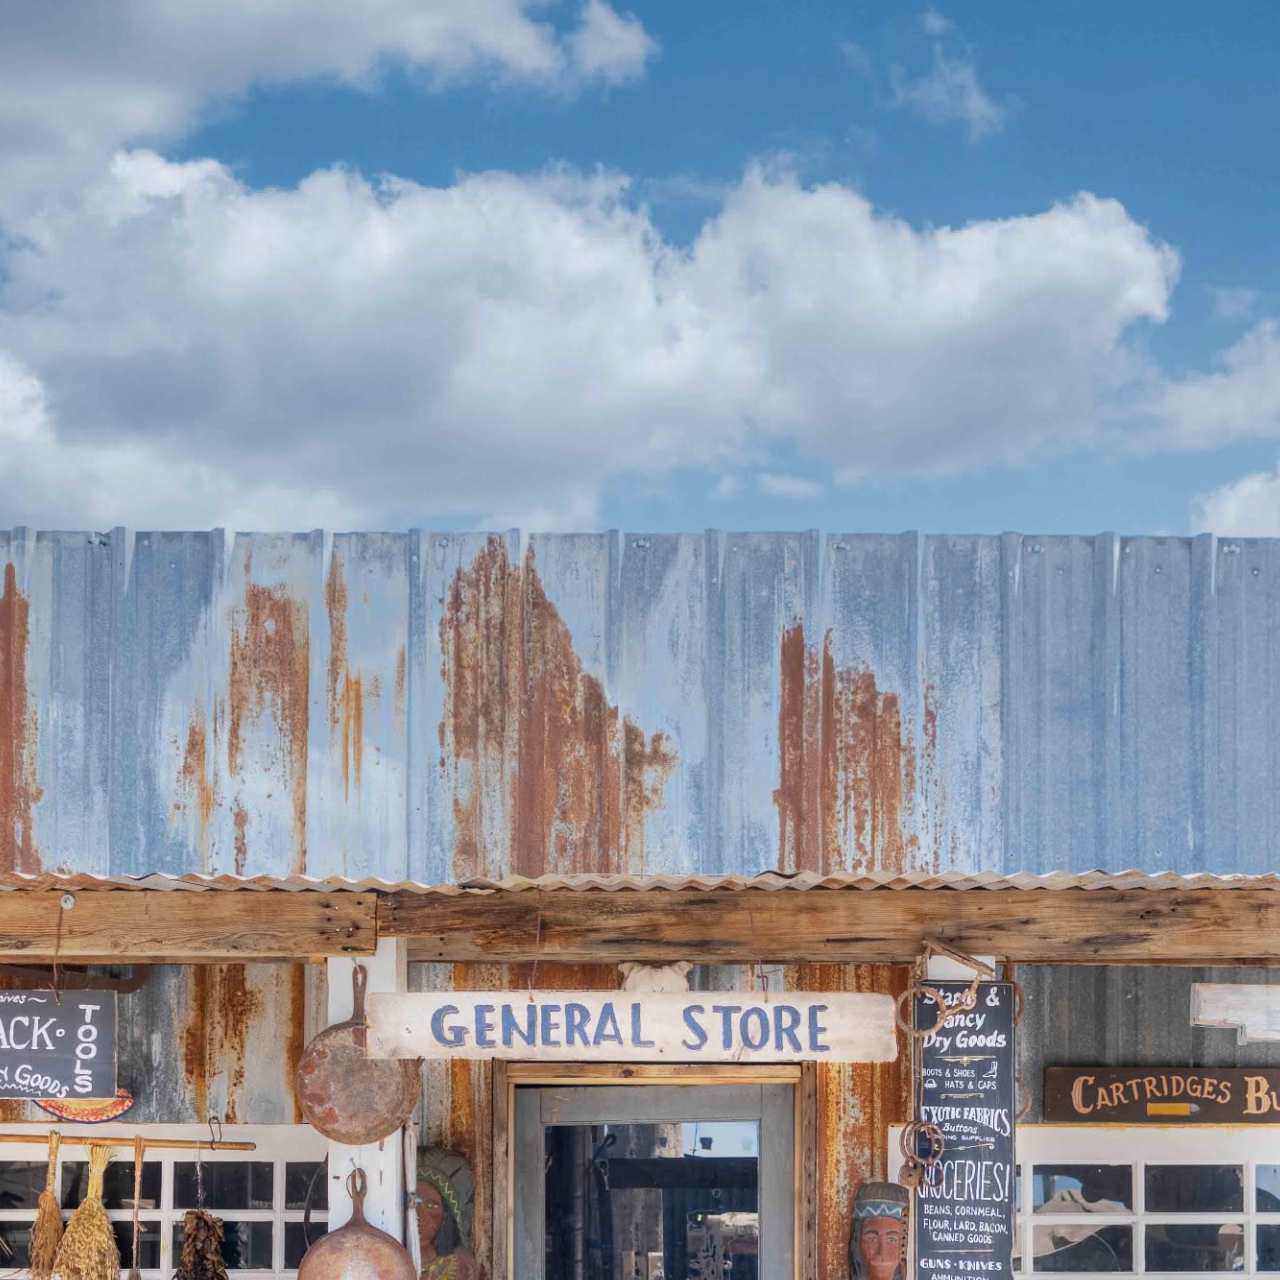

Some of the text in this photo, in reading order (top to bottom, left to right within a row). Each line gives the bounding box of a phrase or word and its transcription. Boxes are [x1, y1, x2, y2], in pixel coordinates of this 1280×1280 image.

[985, 986, 1000, 1006] &
[430, 1002, 831, 1053] GENERAL STORE
[936, 1010, 986, 1031] ancy
[73, 1004, 101, 1093] TOOLS
[923, 1029, 1007, 1053] Dry Goods
[14, 1064, 69, 1098] GOODS
[944, 1068, 951, 1078] &
[953, 1068, 976, 1078] SHOES
[944, 1080, 997, 1090] HATS & CAPS
[1070, 1075, 1232, 1115] CARTRIDGES
[942, 1122, 978, 1134] Buttons
[963, 1107, 1010, 1137] FABRICS
[932, 1231, 993, 1244] CANNED GOODS
[919, 1258, 1003, 1271] GUNS KNIVES
